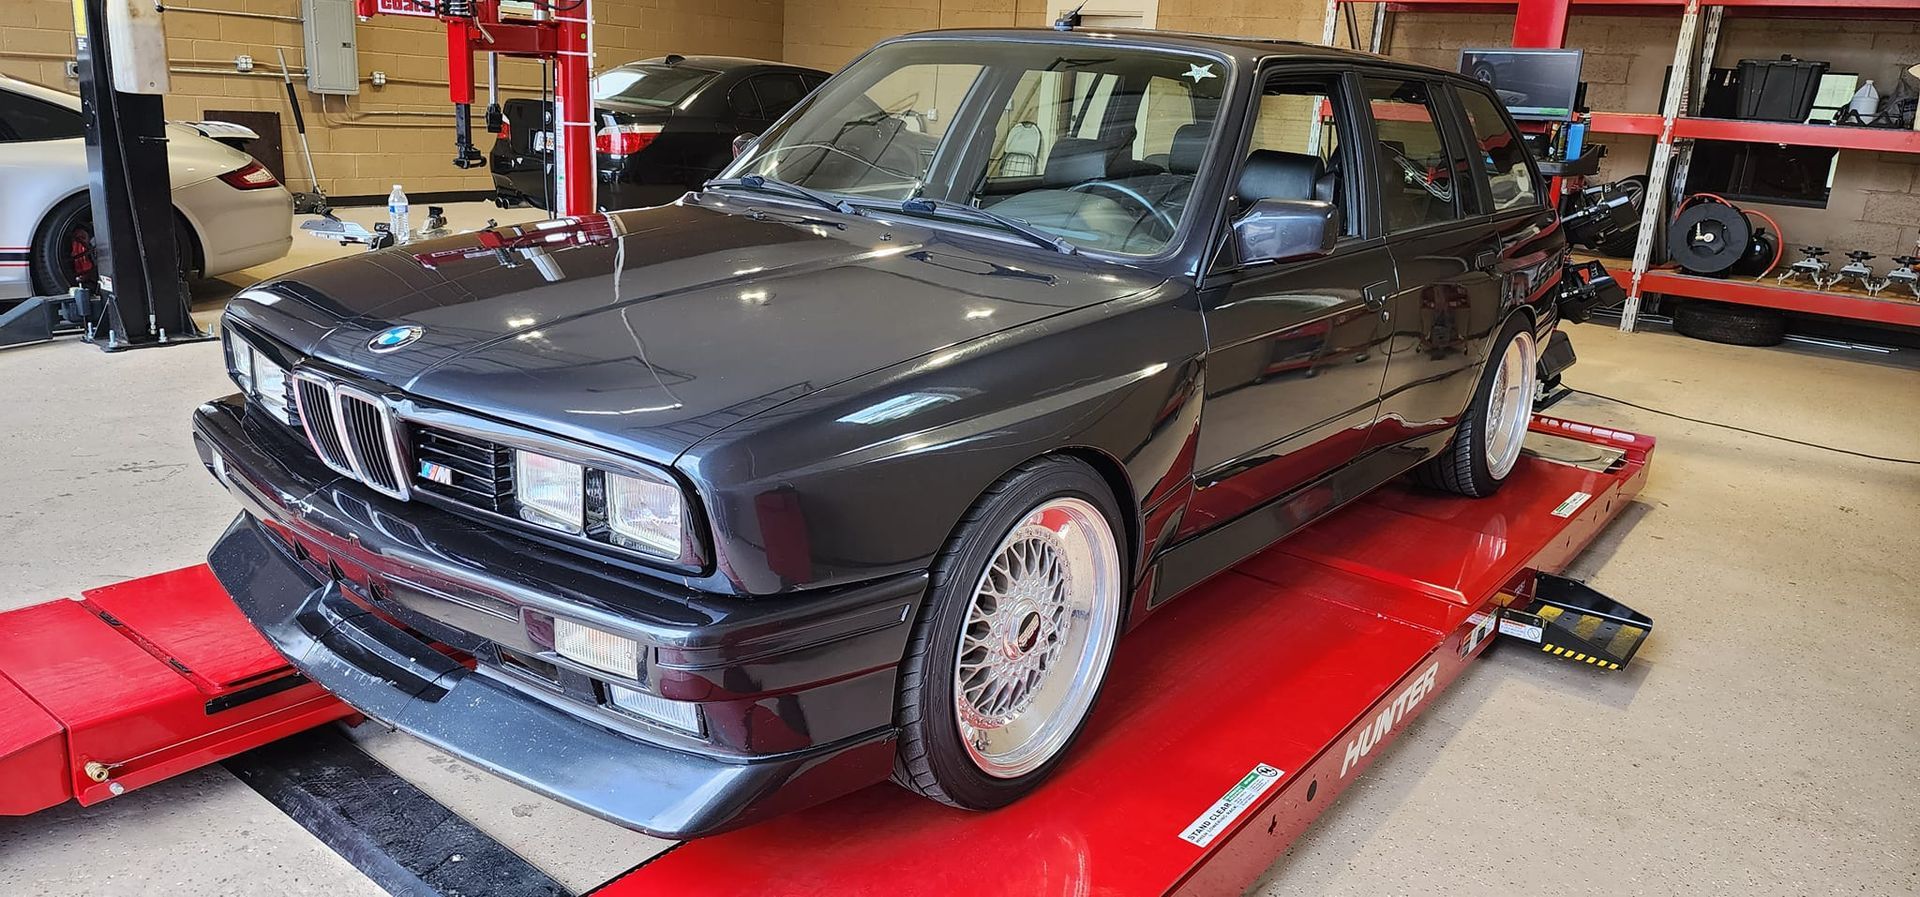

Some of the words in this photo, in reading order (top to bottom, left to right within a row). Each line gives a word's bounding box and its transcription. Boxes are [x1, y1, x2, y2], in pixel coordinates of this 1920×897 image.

[1340, 661, 1439, 779] HUNTER
[1187, 820, 1212, 841] STAND
[1209, 802, 1231, 821] CLEAR
